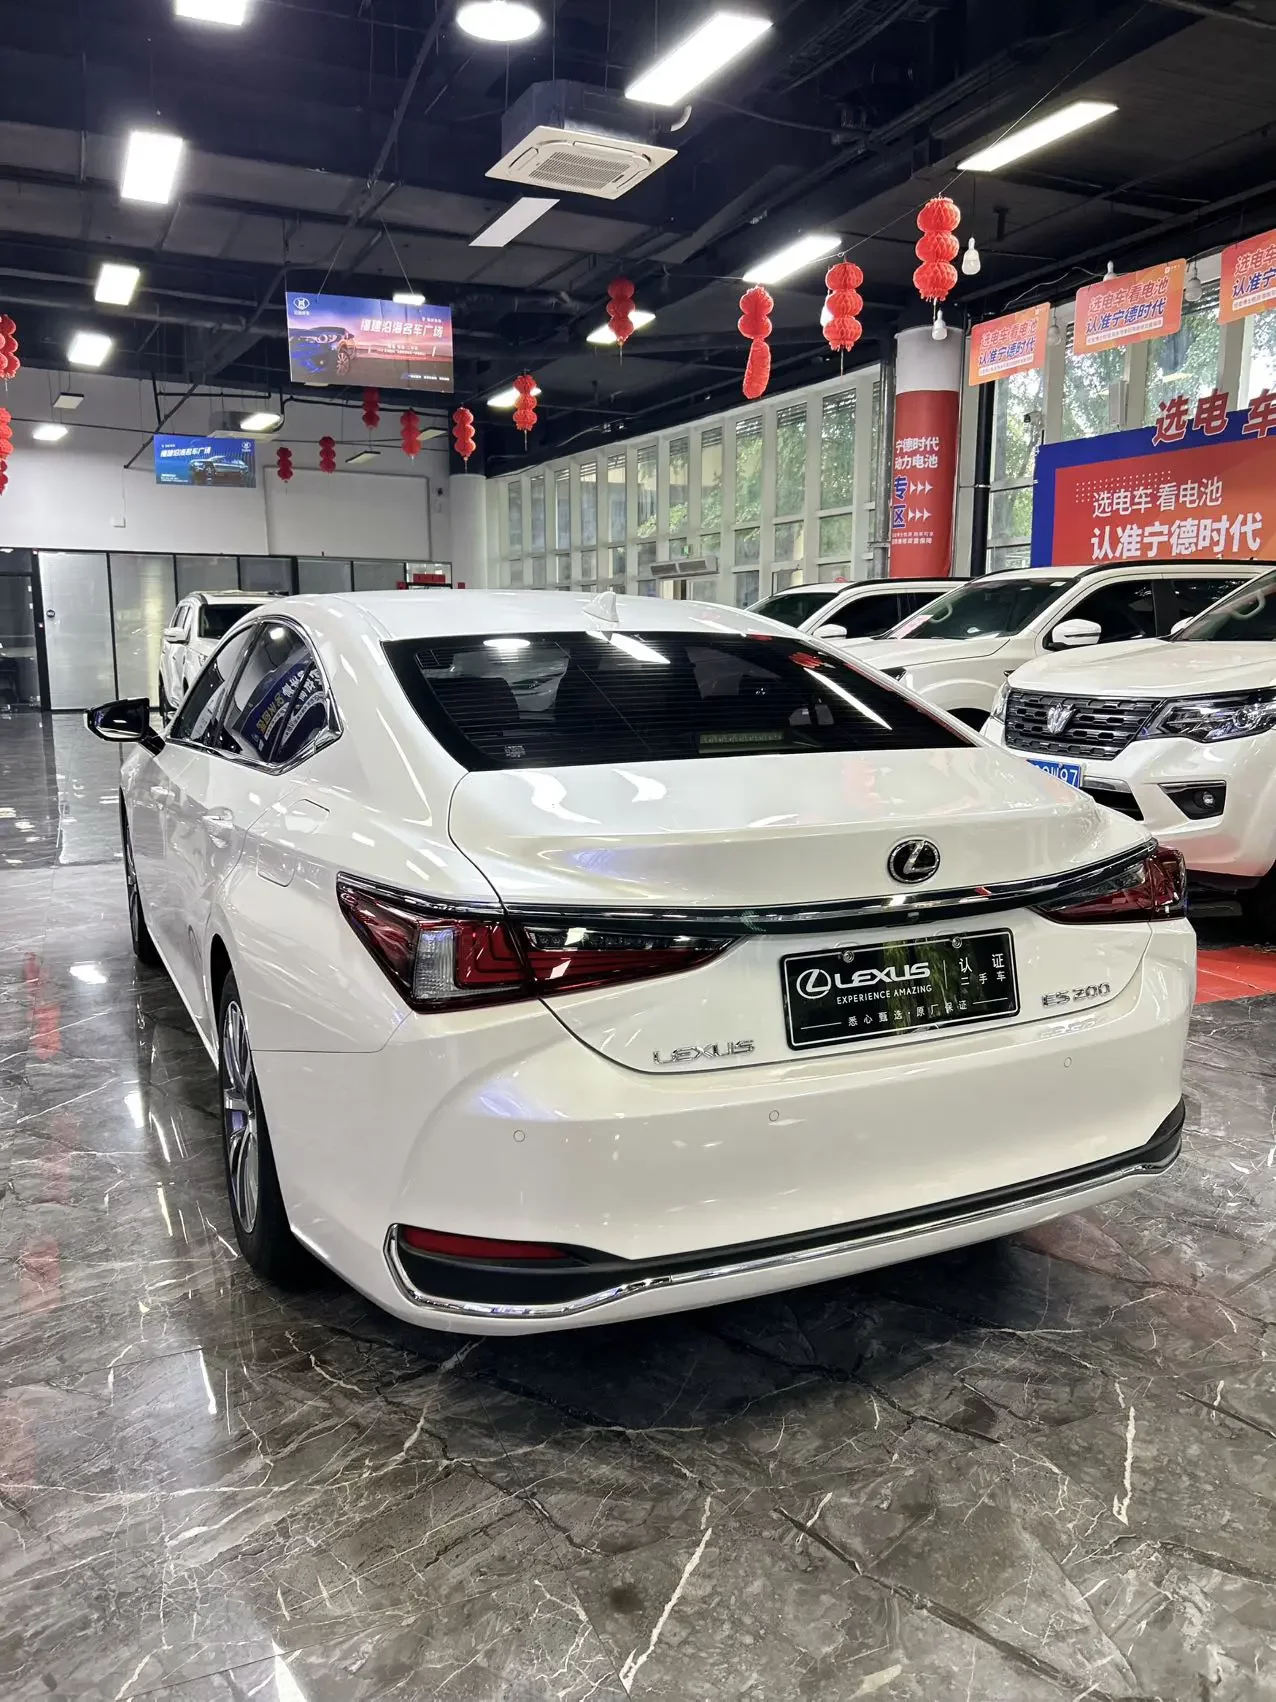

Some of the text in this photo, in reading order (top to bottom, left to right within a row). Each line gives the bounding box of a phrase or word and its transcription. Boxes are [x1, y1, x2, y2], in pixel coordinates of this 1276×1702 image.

[1086, 297, 1167, 334] 认准宁德时代
[1090, 512, 1263, 561] 认准宁德时代
[834, 961, 931, 989] LEXUS
[836, 984, 933, 1005] EXPERIENCE AMAZING
[652, 1039, 755, 1065] LEXUS
